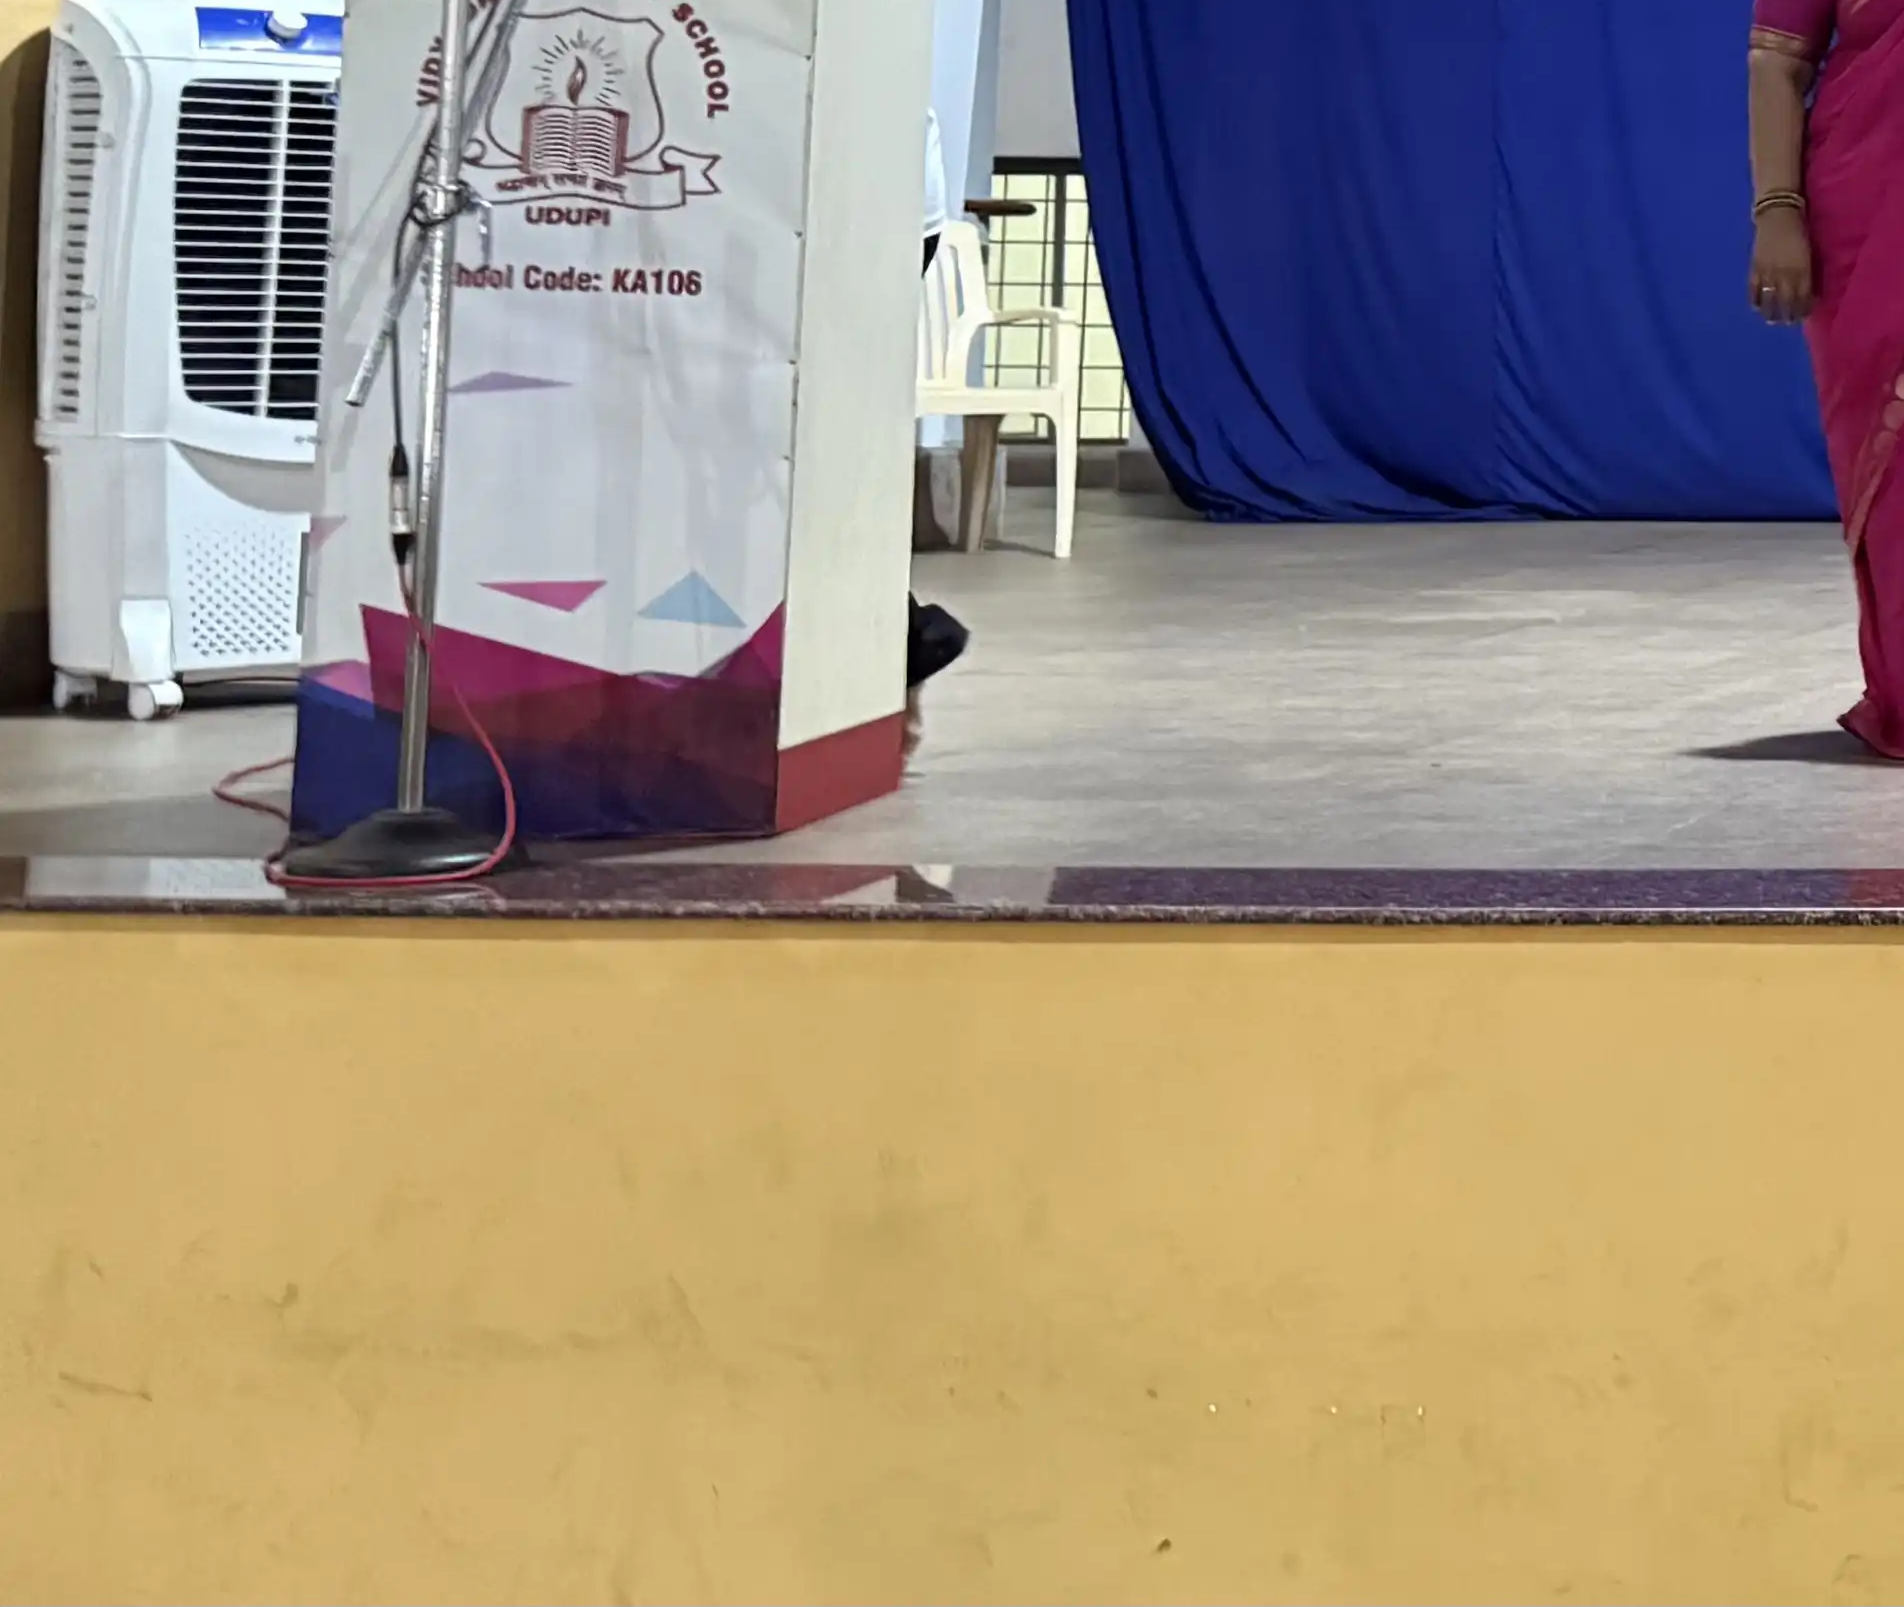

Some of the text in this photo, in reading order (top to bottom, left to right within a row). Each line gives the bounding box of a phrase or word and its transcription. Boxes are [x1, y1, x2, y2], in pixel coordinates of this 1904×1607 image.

[671, 2, 729, 119] SCHOOL
[525, 205, 610, 226] UDUPI
[523, 265, 602, 292] Code:
[612, 268, 703, 296] KA106
